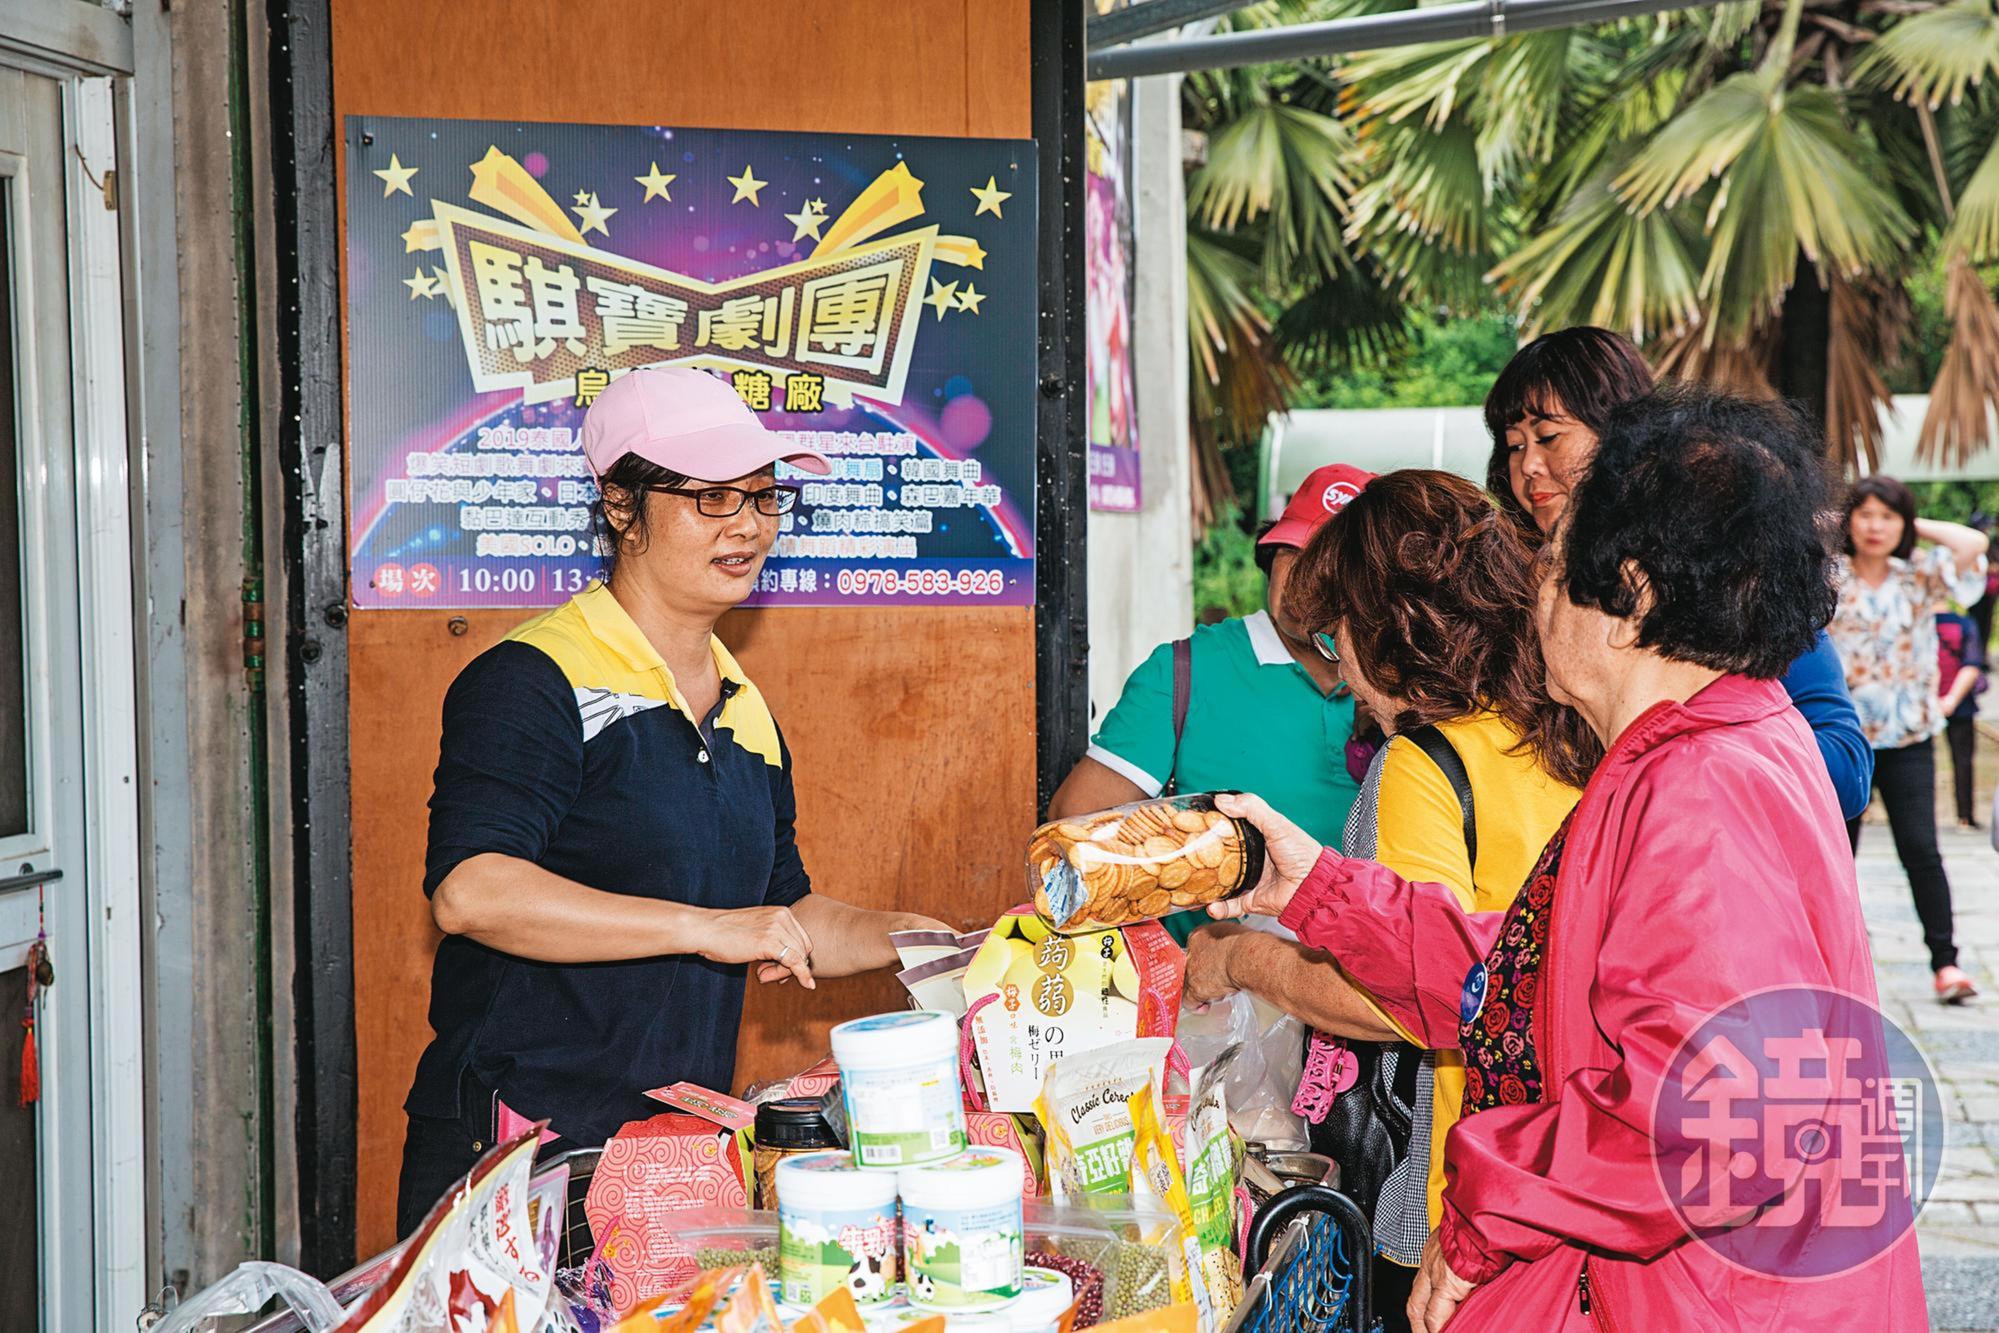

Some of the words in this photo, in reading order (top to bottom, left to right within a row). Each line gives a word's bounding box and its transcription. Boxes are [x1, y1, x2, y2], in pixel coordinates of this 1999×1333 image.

[575, 368, 823, 412] 烏糖廠
[378, 568, 437, 593] 場次
[459, 568, 535, 593] 10:00
[838, 569, 1003, 595] 0978-583-926
[1070, 1094, 1100, 1125] Classic
